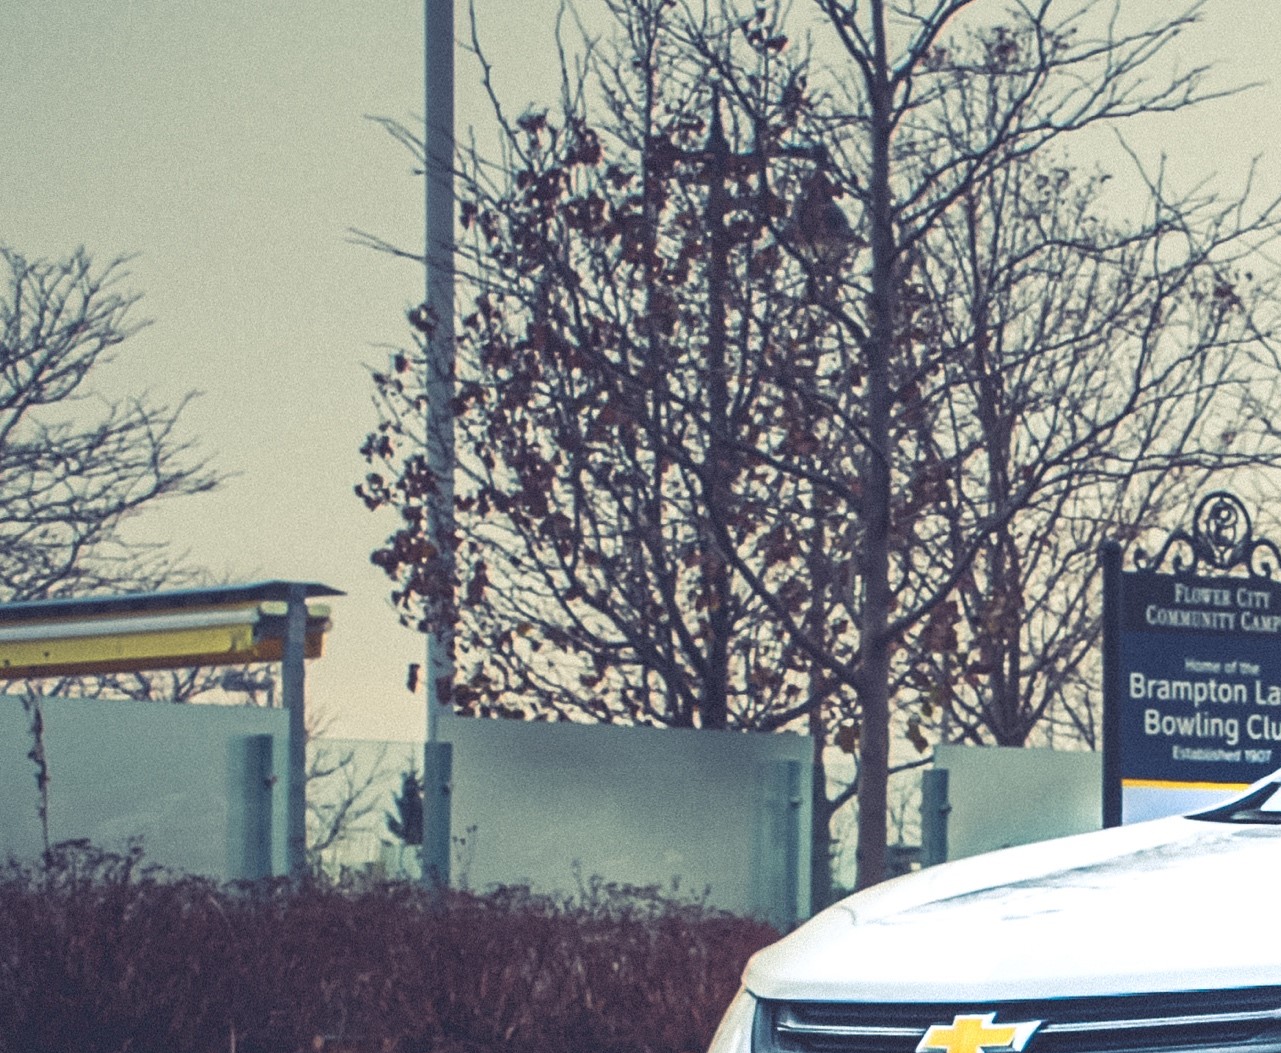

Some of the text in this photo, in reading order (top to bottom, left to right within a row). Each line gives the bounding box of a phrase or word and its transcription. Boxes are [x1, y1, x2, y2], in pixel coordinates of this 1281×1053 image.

[1184, 658, 1261, 676] Home of the
[1129, 673, 1247, 707] Brampton
[1144, 709, 1239, 745] Bowling
